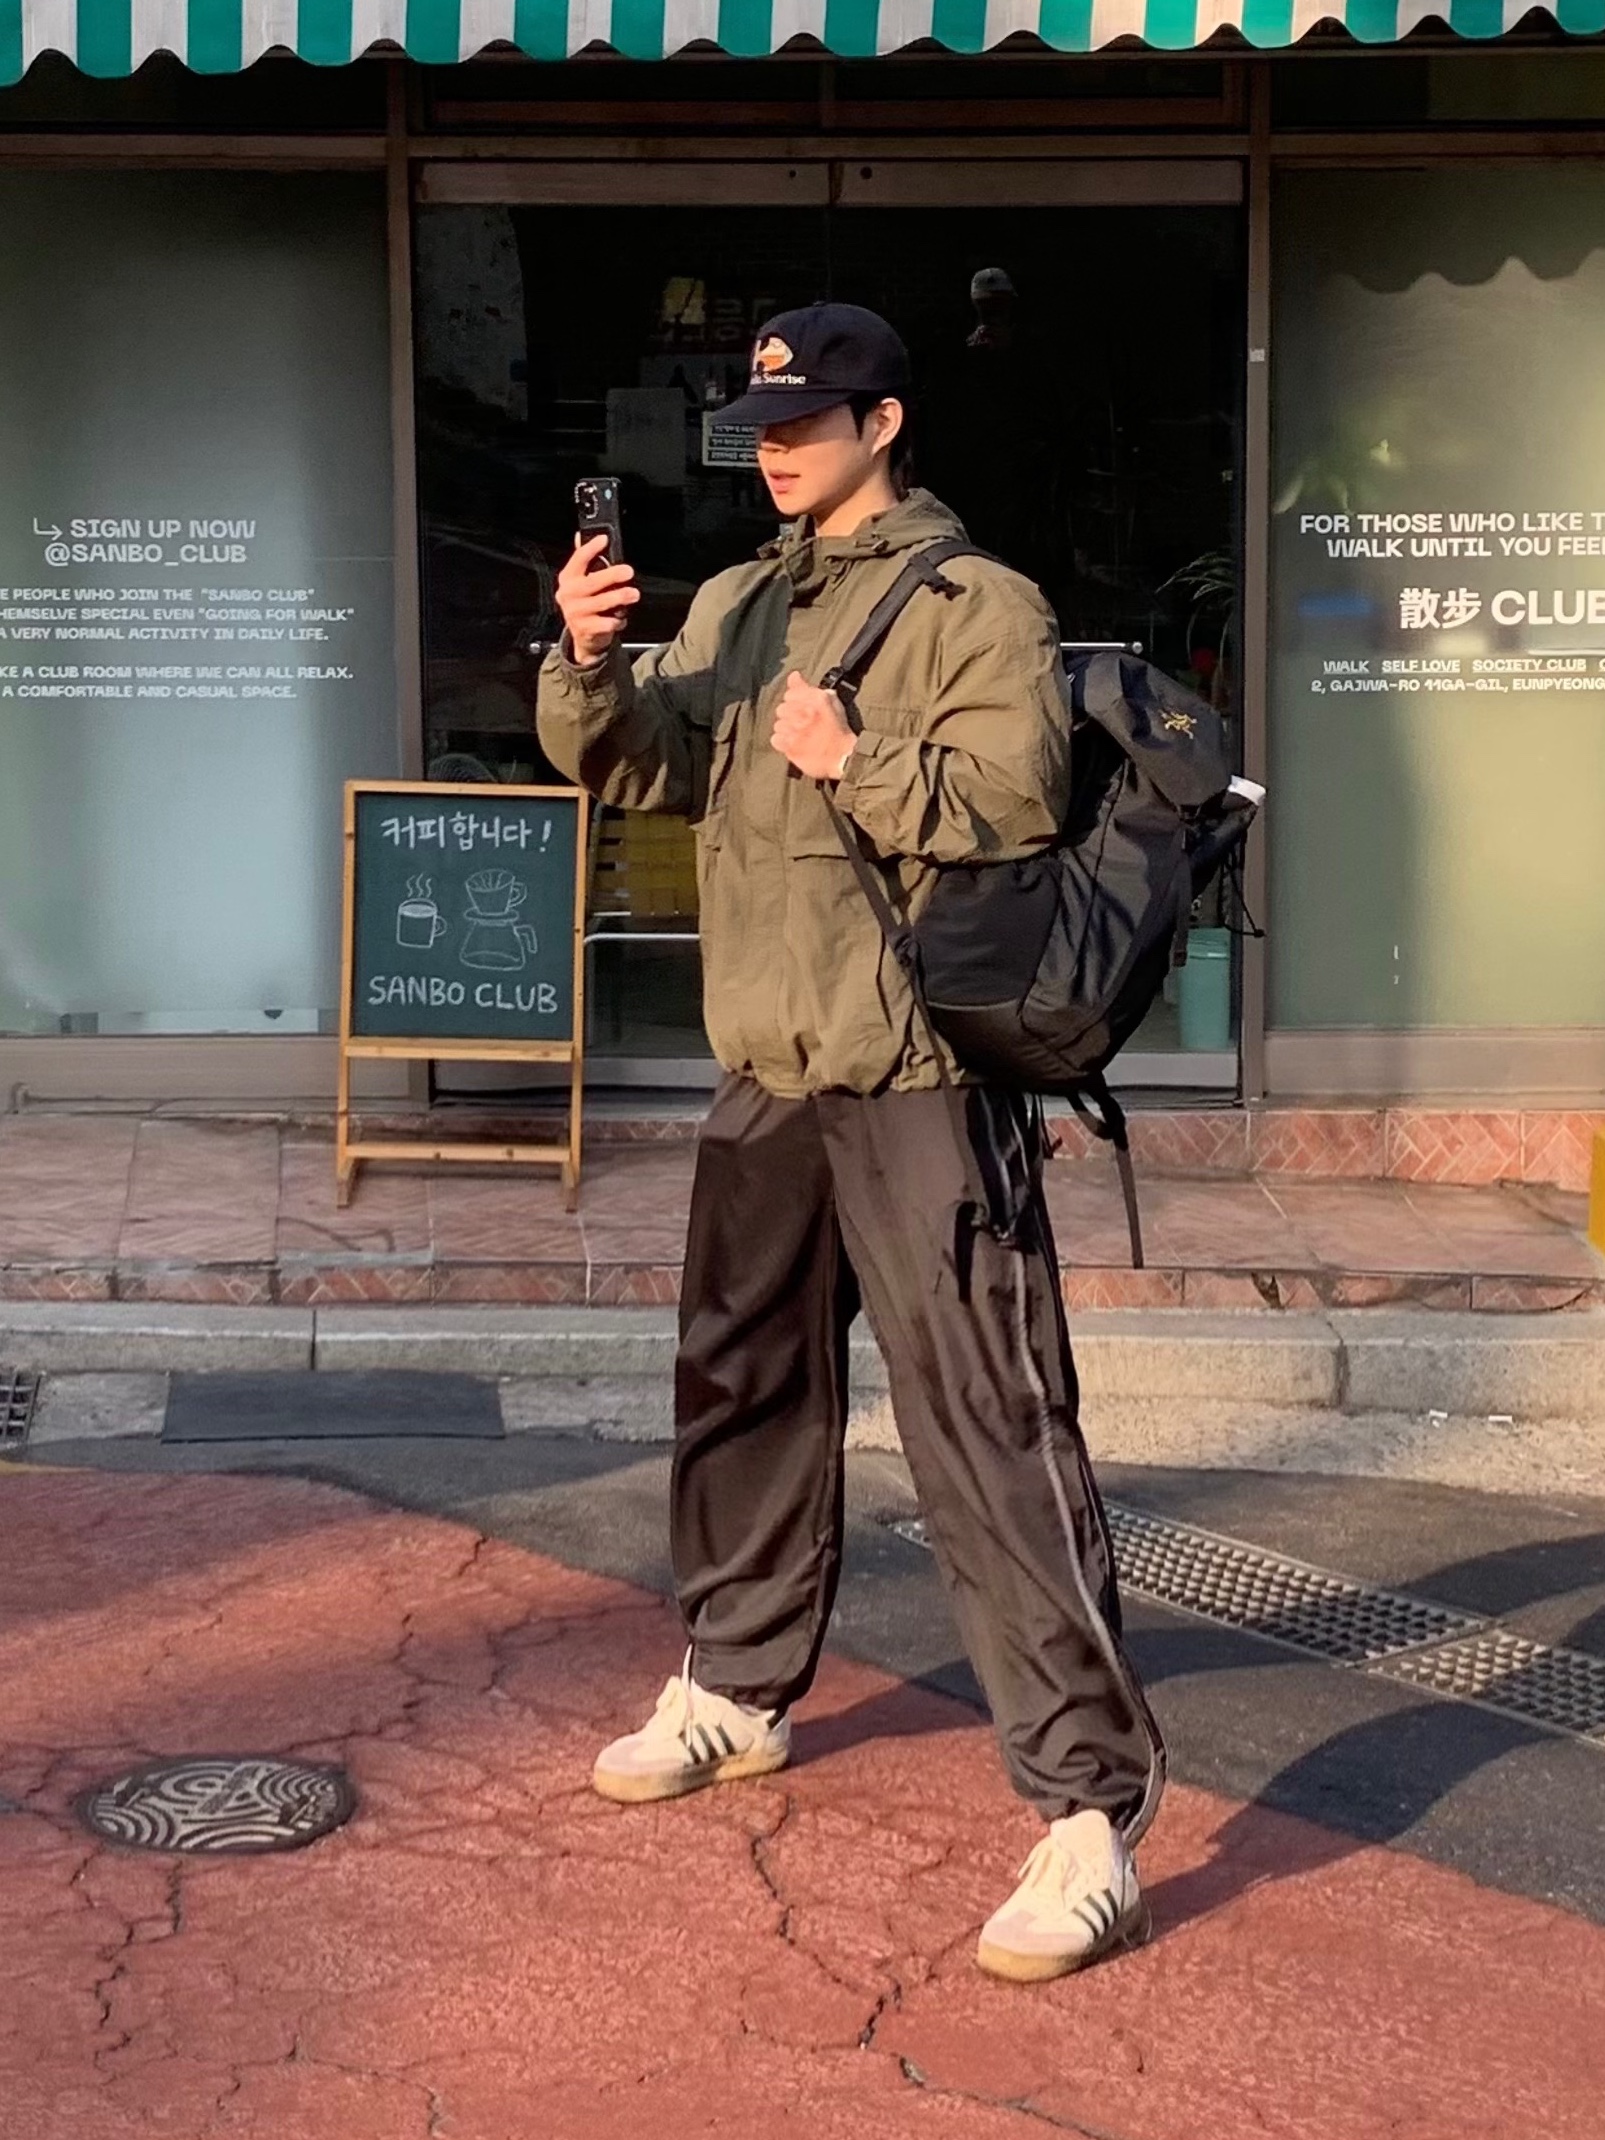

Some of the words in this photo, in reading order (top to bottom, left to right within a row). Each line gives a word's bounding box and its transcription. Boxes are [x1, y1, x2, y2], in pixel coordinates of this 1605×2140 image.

[70, 519, 140, 539] SIGN
[148, 519, 181, 539] UP
[189, 519, 257, 539] NOW
[1300, 514, 1350, 534] FOR
[1357, 513, 1443, 533] THOSE
[1449, 513, 1516, 533] WHO
[1522, 512, 1584, 532] LIKE
[44, 543, 248, 567] @SANBO_CLUB
[1326, 538, 1404, 558] WALK
[1410, 537, 1492, 557] UNTIL
[1498, 536, 1551, 556] YOU
[13, 588, 71, 601] PEOPLE
[74, 588, 115, 601] WHO
[118, 588, 160, 601] JOIN
[163, 588, 193, 601] THE
[201, 588, 263, 601] "SANBO
[266, 588, 315, 601] CLUB"
[81, 608, 150, 620] SPECIAL
[153, 608, 195, 620] EVEN
[265, 608, 298, 621] FOR
[300, 608, 355, 621] WALK"
[1399, 587, 1482, 629] 散步
[10, 627, 52, 640] VERY
[55, 627, 125, 640] NORMAL
[128, 627, 210, 640] ACTIVITY
[214, 628, 234, 640] IN
[238, 628, 285, 640] DAILY
[289, 628, 329, 640] LIFE.
[22, 666, 34, 679] A
[38, 666, 79, 679] CLUB
[82, 666, 132, 679] ROOM
[135, 666, 193, 679] WHERE
[196, 666, 223, 679] WE
[226, 666, 261, 679] CAN
[265, 666, 294, 679] ALL
[297, 666, 354, 679] RELAX.
[1323, 660, 1370, 674] WALK
[1381, 659, 1419, 673] SELF
[1421, 659, 1461, 673] LOVE
[1472, 658, 1543, 672] SOCIETY
[1546, 658, 1587, 672] CLUB
[2, 685, 14, 698] A
[17, 685, 134, 698] COMFORTABLE
[137, 685, 171, 698] AND
[175, 686, 238, 698] CASUAL
[241, 686, 298, 698] SPACE.
[1311, 680, 1326, 694] 2,
[1329, 679, 1421, 692] GAJWA-RO
[368, 976, 465, 1006] SANBO
[475, 982, 559, 1013] CLUB
